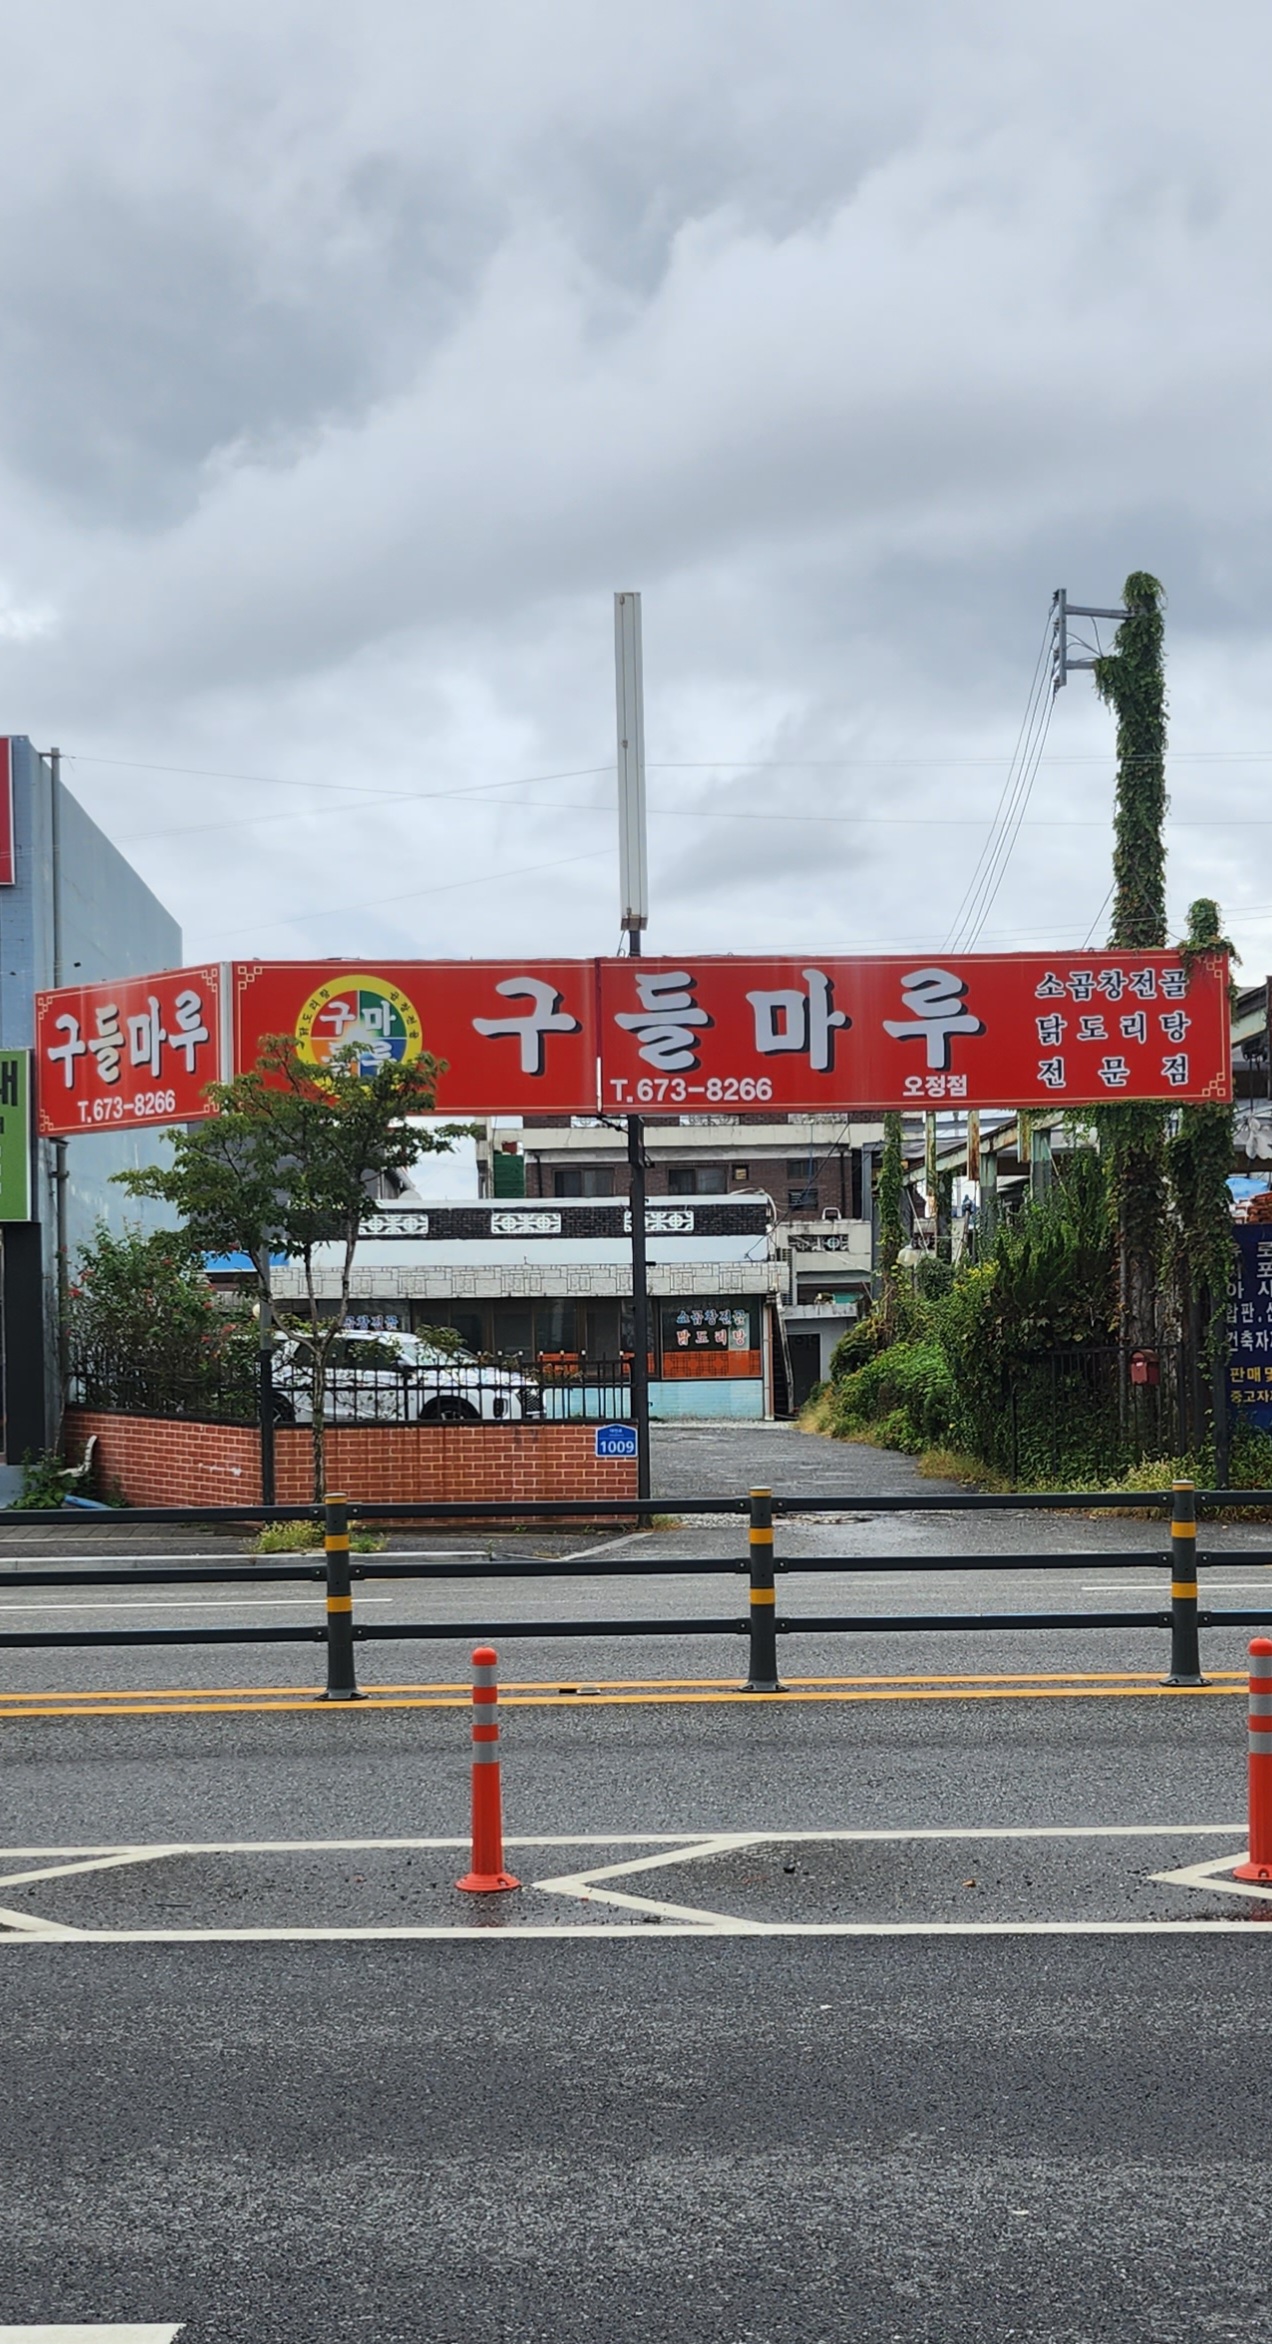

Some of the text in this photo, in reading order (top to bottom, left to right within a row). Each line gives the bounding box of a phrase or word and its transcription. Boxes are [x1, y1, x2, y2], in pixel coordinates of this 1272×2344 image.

[1034, 968, 1189, 1002] 소곱창전골
[47, 989, 209, 1089] 구들마루
[1035, 1010, 1192, 1046] 닭도리탕
[1037, 1053, 1190, 1089] 전문점
[610, 1078, 774, 1103] T.673-8266
[902, 1075, 968, 1098] 오정점
[77, 1089, 176, 1124] T.673-8266
[1226, 1329, 1272, 1352] 건축자
[1230, 1390, 1272, 1404] 중고자
[600, 1440, 634, 1454] 1009
